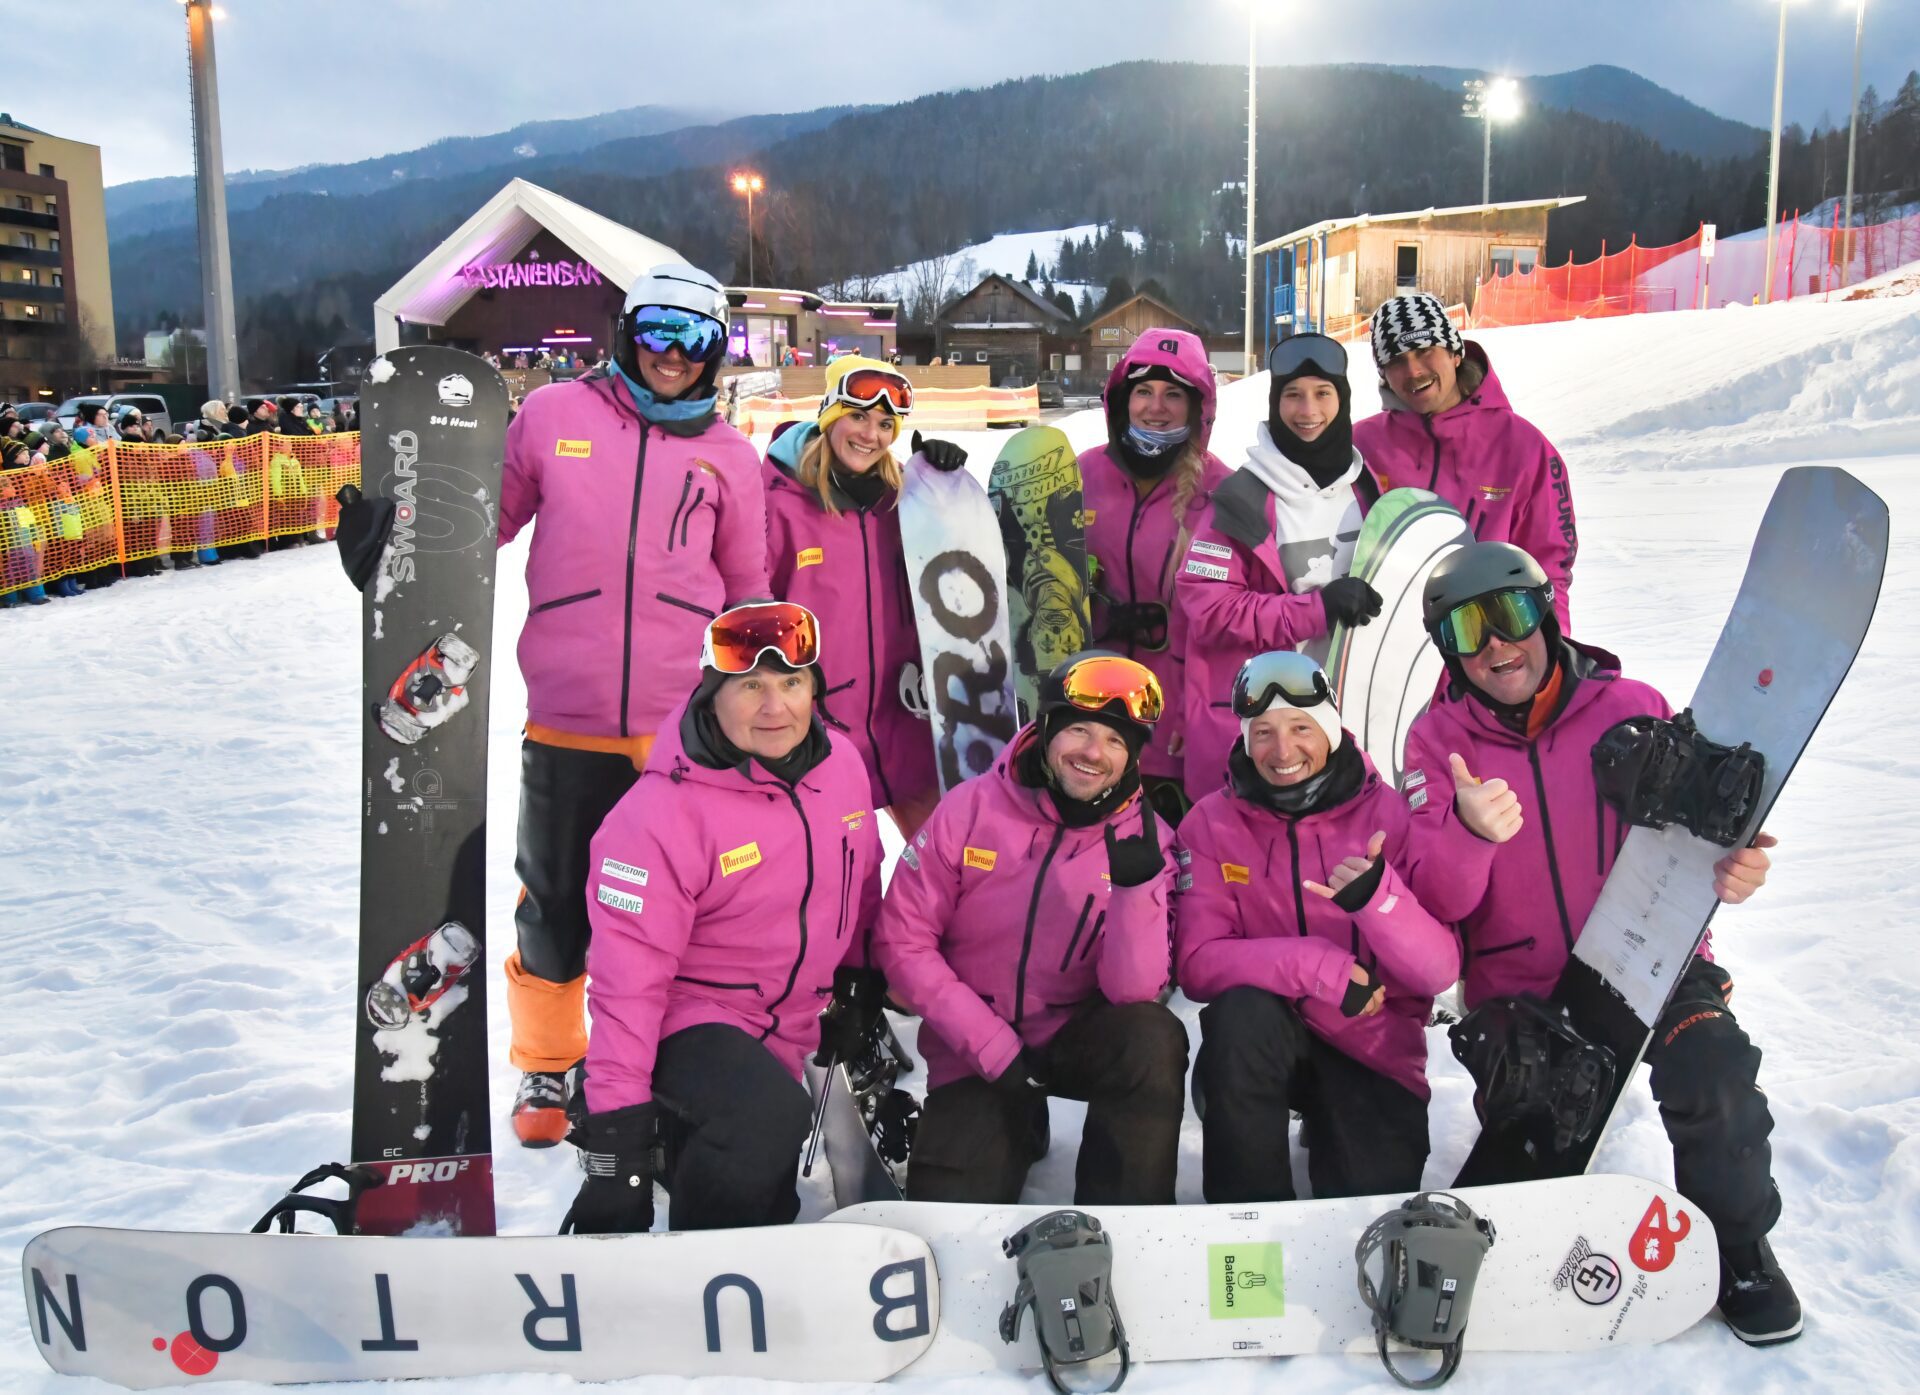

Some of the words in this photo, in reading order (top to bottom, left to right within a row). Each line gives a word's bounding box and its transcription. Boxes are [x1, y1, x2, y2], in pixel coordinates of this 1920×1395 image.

[391, 429, 418, 584] SWOARD
[1195, 565, 1228, 580] GRAWE
[603, 858, 647, 879] BRIDGESTONE
[721, 849, 758, 872] Murauer
[966, 849, 995, 867] Murauer
[606, 893, 642, 913] GRAWE
[383, 1147, 403, 1158] EC
[1224, 1255, 1236, 1308] Bataleon
[30, 1256, 931, 1353] BURTON
[1607, 1295, 1635, 1341] sequence
